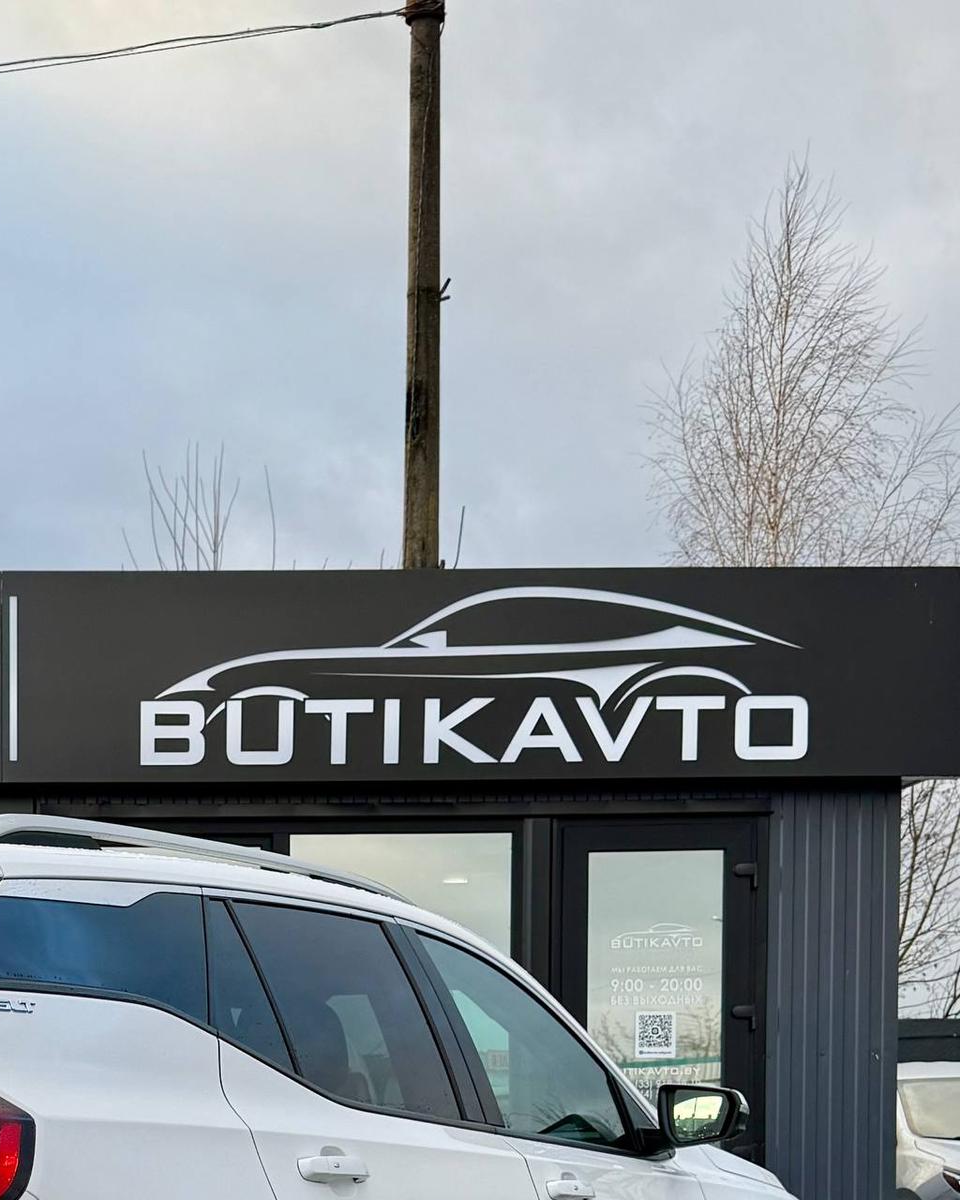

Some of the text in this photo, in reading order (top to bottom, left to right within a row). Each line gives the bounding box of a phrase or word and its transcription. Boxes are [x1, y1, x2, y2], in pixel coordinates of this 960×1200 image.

[140, 695, 809, 766] BUTIKAVTO
[611, 937, 703, 949] BUTIKAVTO
[611, 979, 643, 992] 9:00
[660, 978, 703, 992] 20:00
